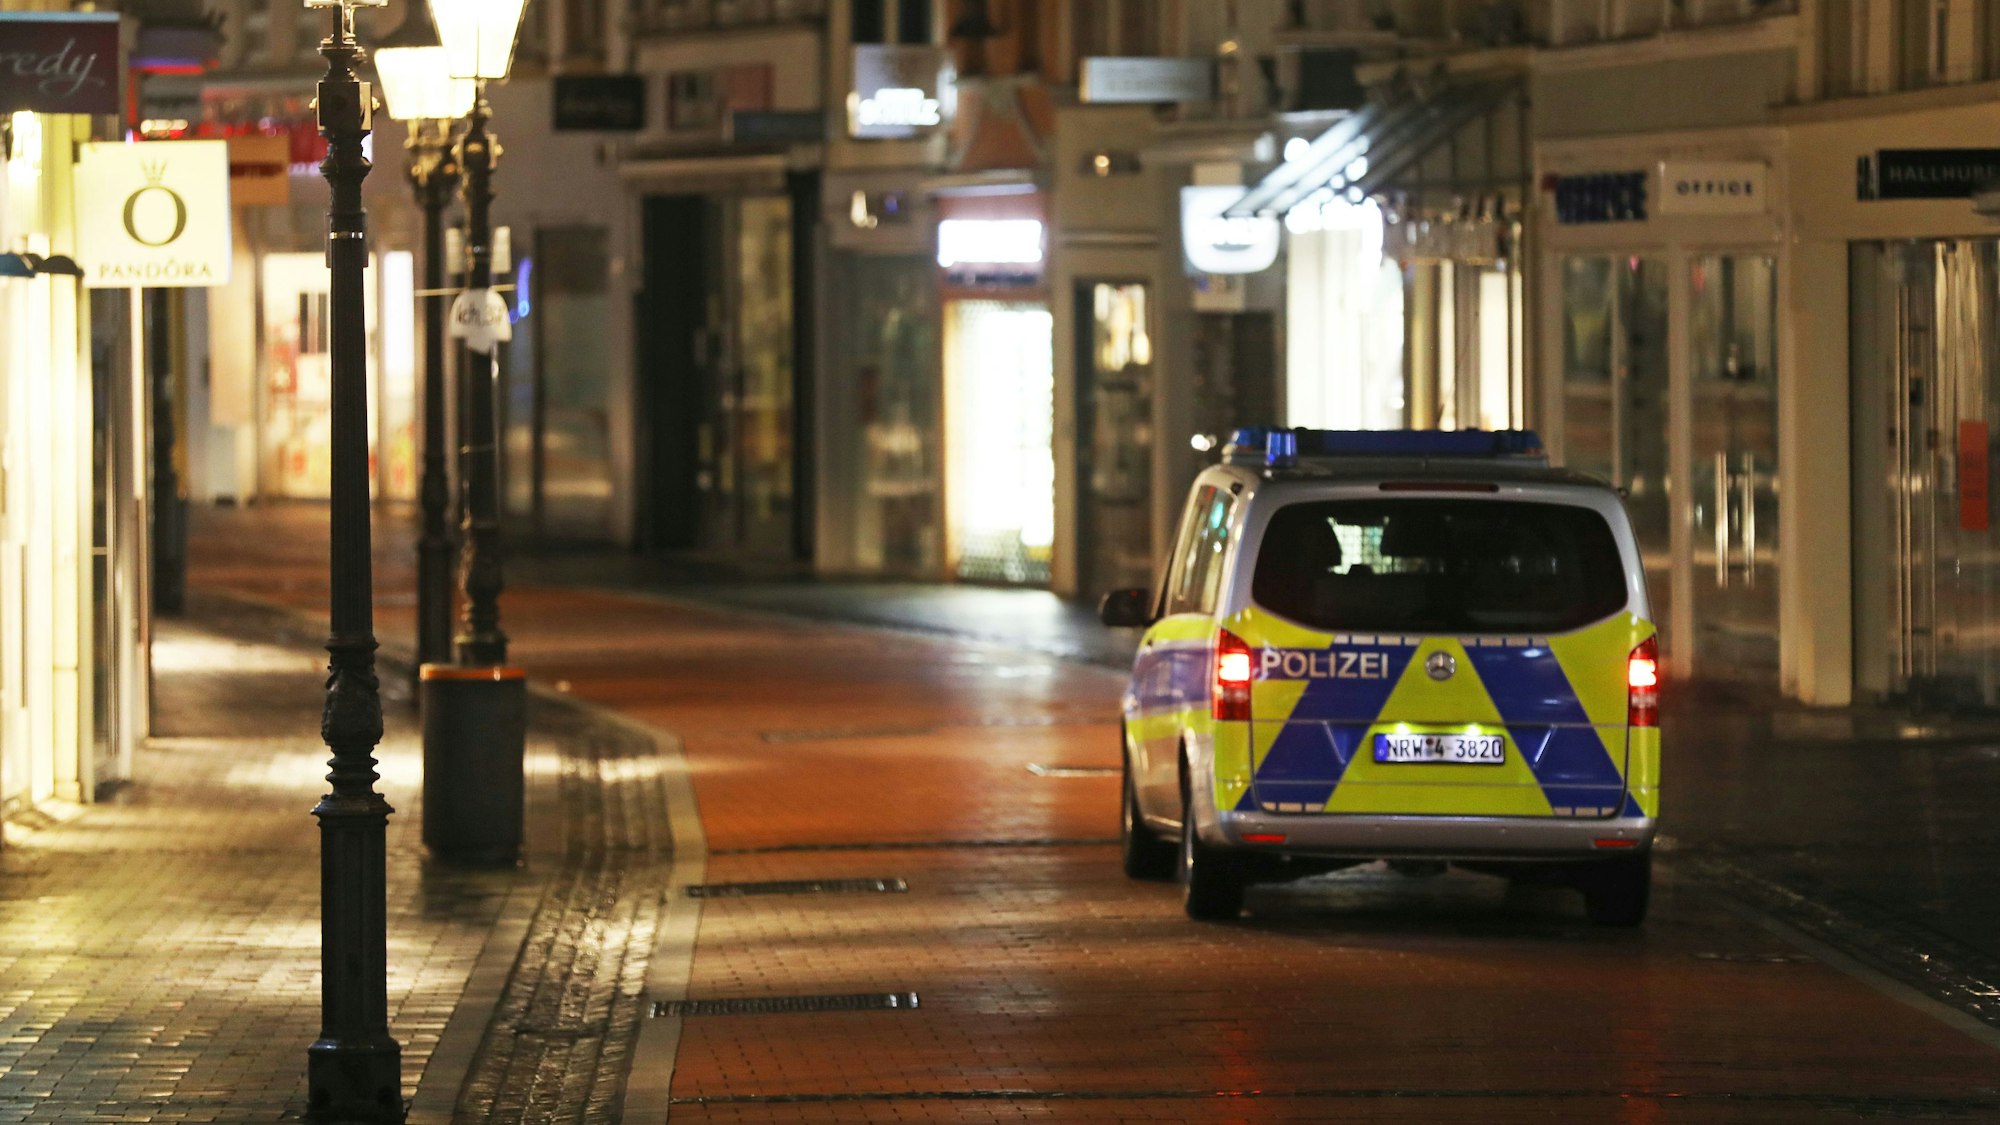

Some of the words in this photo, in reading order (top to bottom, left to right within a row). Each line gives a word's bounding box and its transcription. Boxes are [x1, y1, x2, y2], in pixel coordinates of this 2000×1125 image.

[1677, 180, 1752, 195] OFFICE
[1261, 651, 1388, 679] POLIZEI
[1387, 738, 1423, 757] NRW
[1456, 739, 1502, 758] 3820
